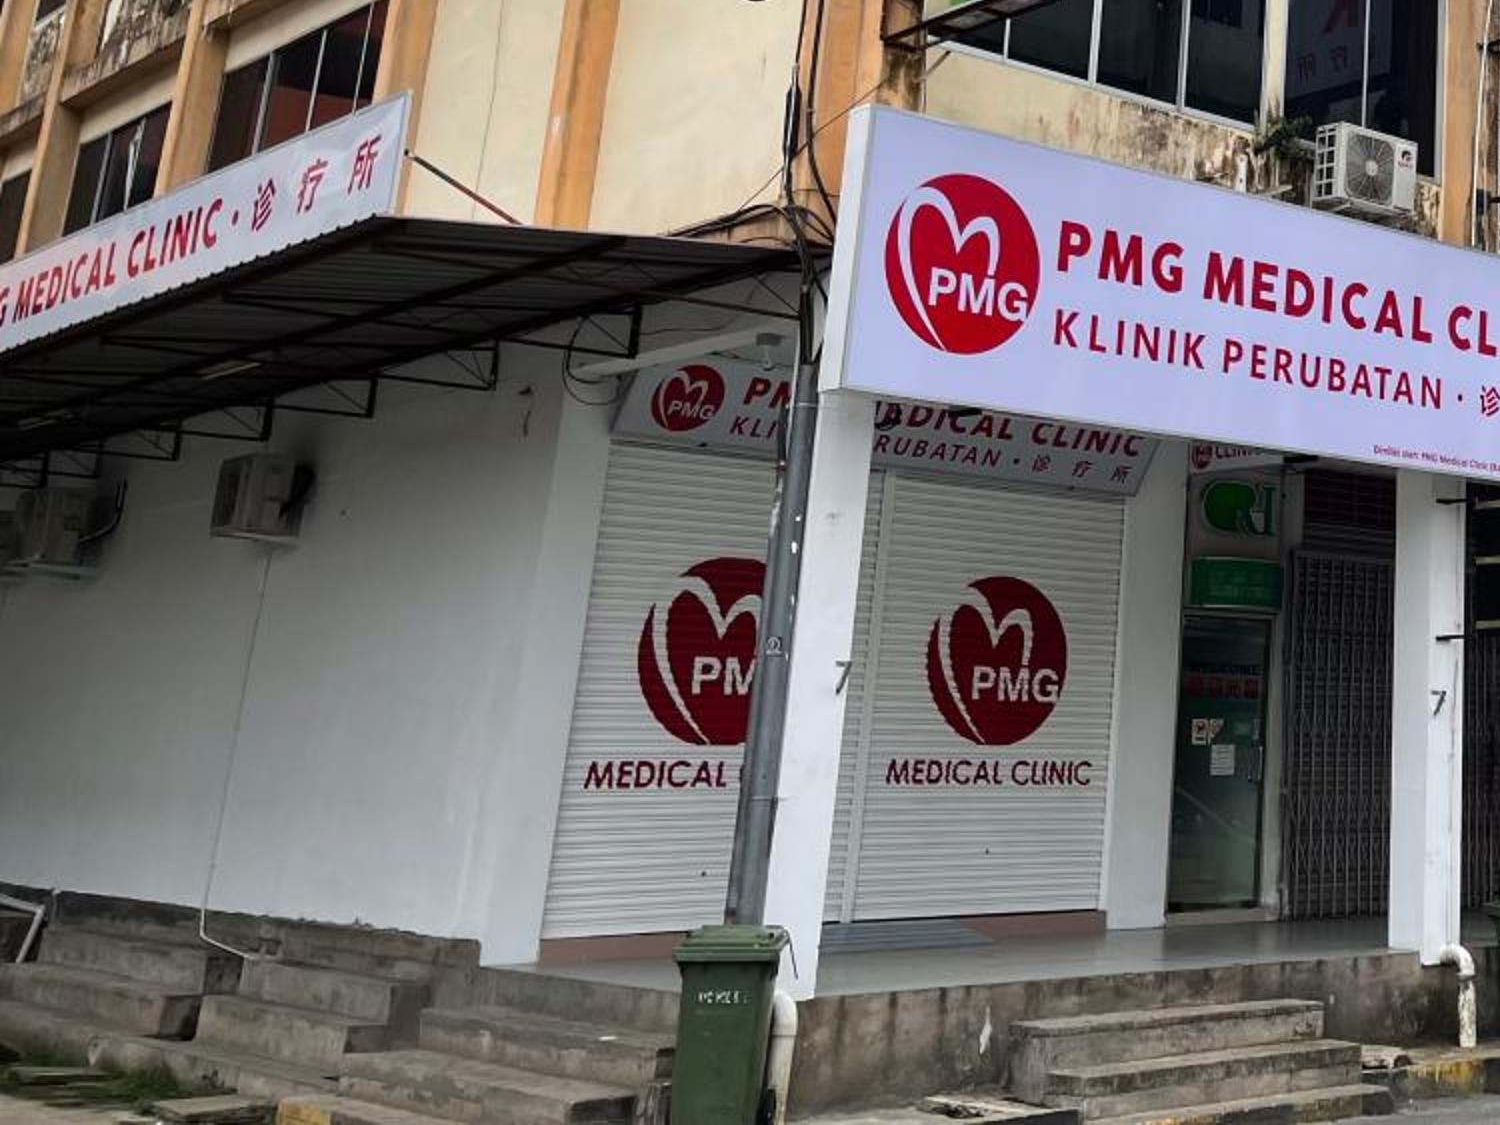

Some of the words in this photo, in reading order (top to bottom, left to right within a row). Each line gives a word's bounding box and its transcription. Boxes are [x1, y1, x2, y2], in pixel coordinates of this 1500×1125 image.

[250, 135, 383, 232] 诊疗所
[13, 241, 116, 324] MEDICAL
[127, 197, 223, 279] CLINIC
[928, 266, 1030, 323] PMG
[1057, 220, 1184, 294] PMG
[1203, 251, 1432, 344] MEDICAL
[1054, 309, 1206, 369] KLINIK
[1223, 338, 1441, 409] PERUBATAN
[667, 400, 715, 420] PMG
[873, 435, 1002, 467] RUBATAN
[1032, 422, 1146, 457] CLINIC
[691, 656, 755, 696] PM
[835, 660, 853, 696] 7
[971, 665, 1059, 703] PMG
[1430, 690, 1447, 717] 7
[584, 760, 727, 789] MEDICAL
[885, 759, 1003, 786] MEDICAL
[1012, 760, 1093, 786] CLINIC
